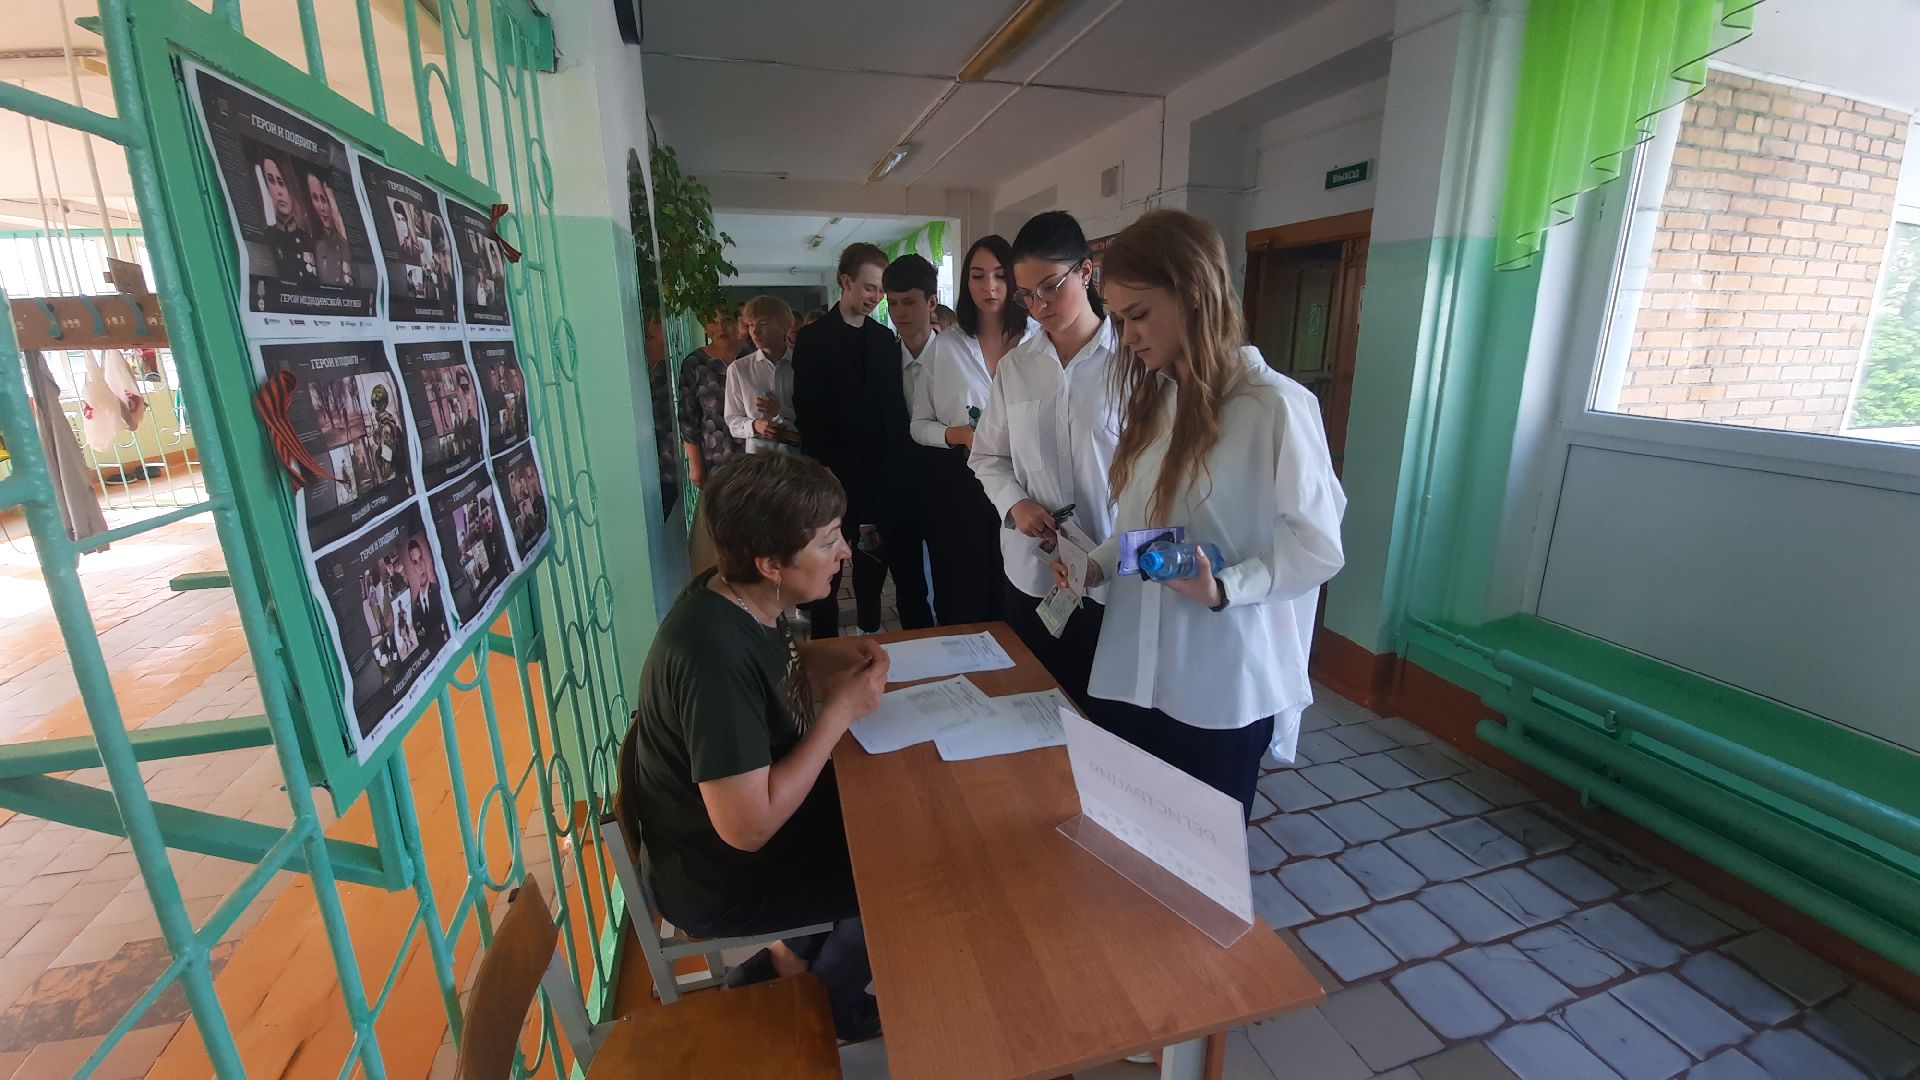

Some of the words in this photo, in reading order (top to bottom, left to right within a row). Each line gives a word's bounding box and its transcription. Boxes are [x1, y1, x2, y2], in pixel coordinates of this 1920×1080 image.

[251, 113, 277, 135] ГЕРОИ
[277, 125, 284, 138] И
[284, 129, 319, 153] ПОДВИГИ
[1332, 168, 1360, 183] ВЫХОД
[280, 293, 299, 304] ГЕРОИ
[310, 358, 335, 370] ГЕРОИ
[359, 542, 375, 562] ГЕРОИ
